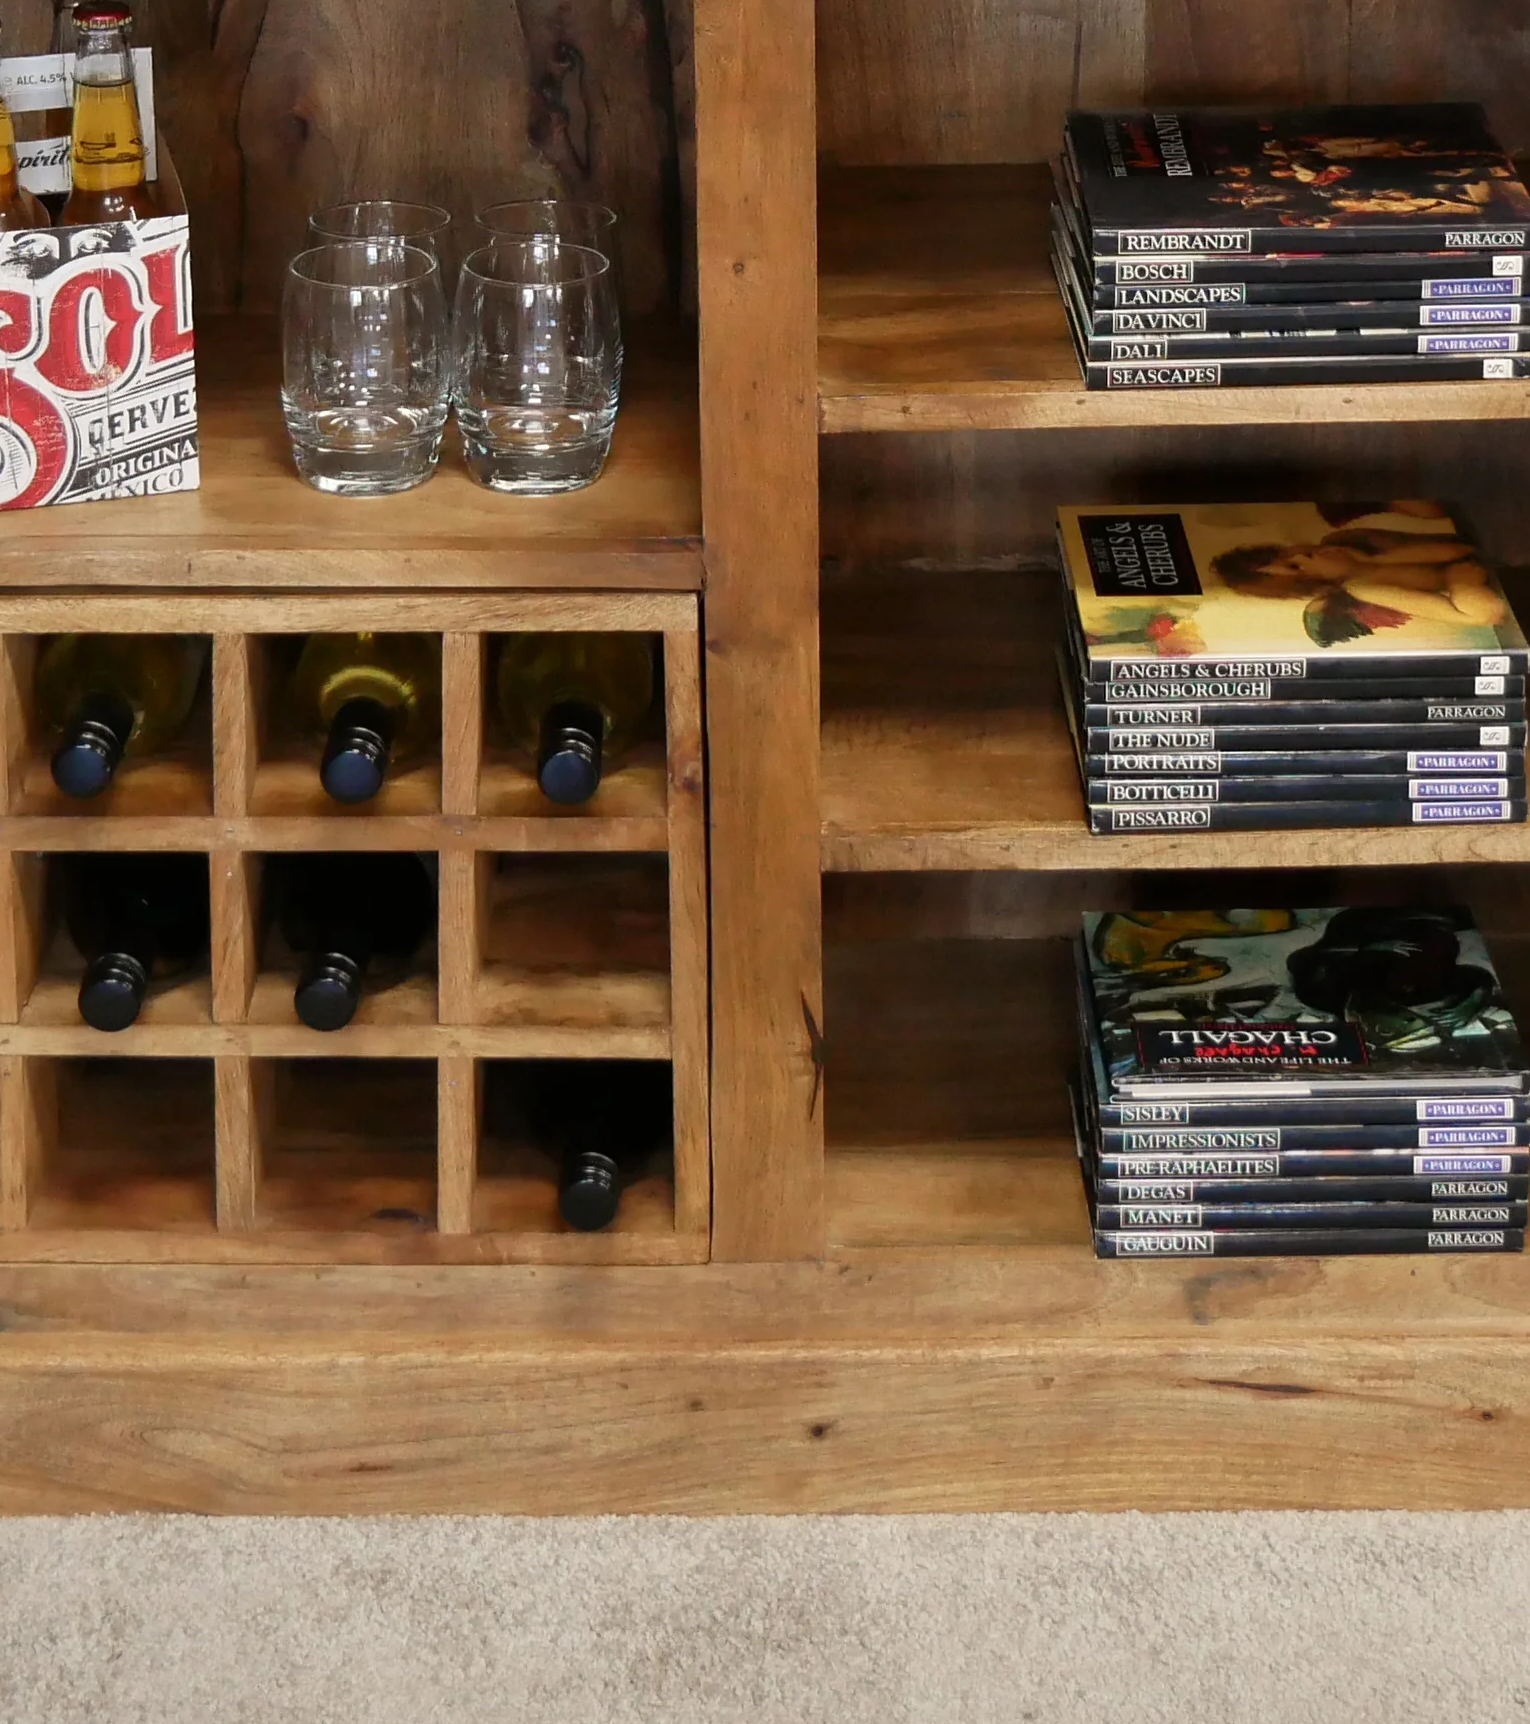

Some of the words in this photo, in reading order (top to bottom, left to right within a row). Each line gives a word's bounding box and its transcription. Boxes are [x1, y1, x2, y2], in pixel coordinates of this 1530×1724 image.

[17, 74, 38, 85] ALC.
[40, 73, 67, 84] 4.5%
[1153, 114, 1192, 176] REMBRANDT
[16, 144, 71, 172] pírit
[1126, 234, 1245, 250] REMBRANDT
[1445, 232, 1525, 246] PARRAGON
[1122, 264, 1188, 280] BOSCH
[1438, 282, 1504, 295] PARRAGON
[1120, 287, 1241, 305] LANDSCAPES
[1118, 314, 1145, 329] DA
[1146, 313, 1201, 329] VINCI
[1437, 309, 1503, 321] PARRAGON
[1116, 344, 1162, 359] DALI
[1435, 339, 1501, 350] PARRAGON
[1113, 368, 1216, 384] SEASCAPES
[1106, 521, 1132, 534] &
[1138, 524, 1179, 586] CHERUBS
[1109, 536, 1147, 589] ANGELS
[1119, 664, 1190, 678] ANGELS
[1195, 664, 1210, 677] &
[1215, 662, 1302, 677] CHERUBS
[1111, 682, 1267, 698] GAINSBOROUGH
[1115, 710, 1193, 724] TURNER
[1428, 706, 1505, 719] PARRAGON
[1113, 734, 1152, 748] THE
[1157, 732, 1210, 747] NUDE
[1113, 754, 1217, 770] PORTRAITS
[1424, 757, 1489, 767] PARRAGON
[1113, 785, 1214, 800] BOTTICELLI
[1425, 783, 1492, 794] PARRAGON
[1118, 810, 1207, 826] PISSARRO
[1429, 806, 1494, 817] PARRAGON
[1159, 1030, 1338, 1044] CHAGALL
[1183, 1056, 1242, 1065] WORKS
[1242, 1056, 1278, 1065] AND
[1280, 1056, 1312, 1065] LIFE
[1317, 1056, 1352, 1065] THE
[1124, 1106, 1183, 1121] SISLEY
[1433, 1104, 1497, 1115] PARRAGON
[1131, 1133, 1277, 1149] IMPRESSIONISTS
[1435, 1132, 1499, 1143] PARRAGON
[1430, 1160, 1494, 1170] PARRAGON
[1127, 1185, 1186, 1199] DEGAS
[1432, 1182, 1508, 1195] PARRAGON
[1128, 1210, 1196, 1224] MANET
[1433, 1208, 1509, 1221] PARRAGON
[1124, 1236, 1207, 1251] GAUGUIN
[1428, 1232, 1505, 1245] PARRAGON
